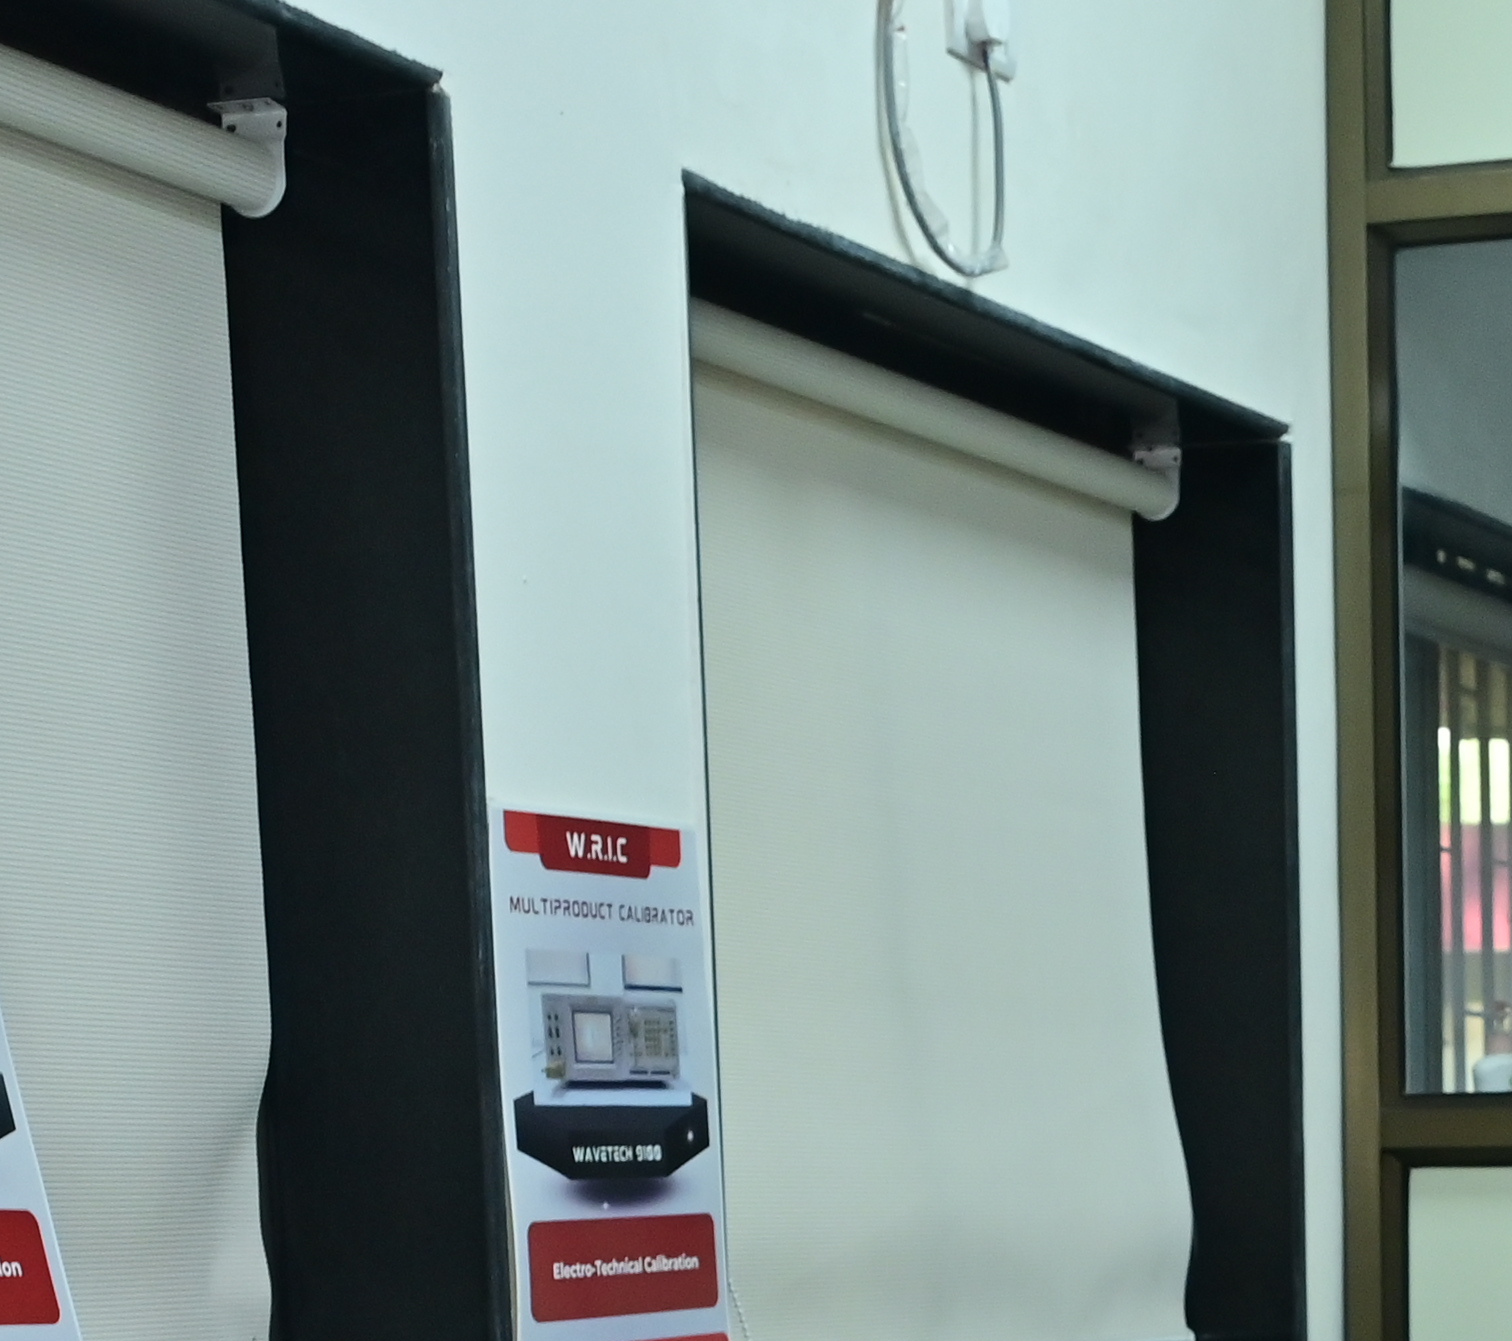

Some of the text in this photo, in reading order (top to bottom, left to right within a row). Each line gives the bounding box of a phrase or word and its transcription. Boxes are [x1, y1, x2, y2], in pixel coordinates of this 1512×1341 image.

[566, 830, 629, 864] W.R.I.C
[509, 895, 695, 927] MULTIPRODUCT CALIBRATOR
[553, 1252, 700, 1280] Electro-Technical Calibration
